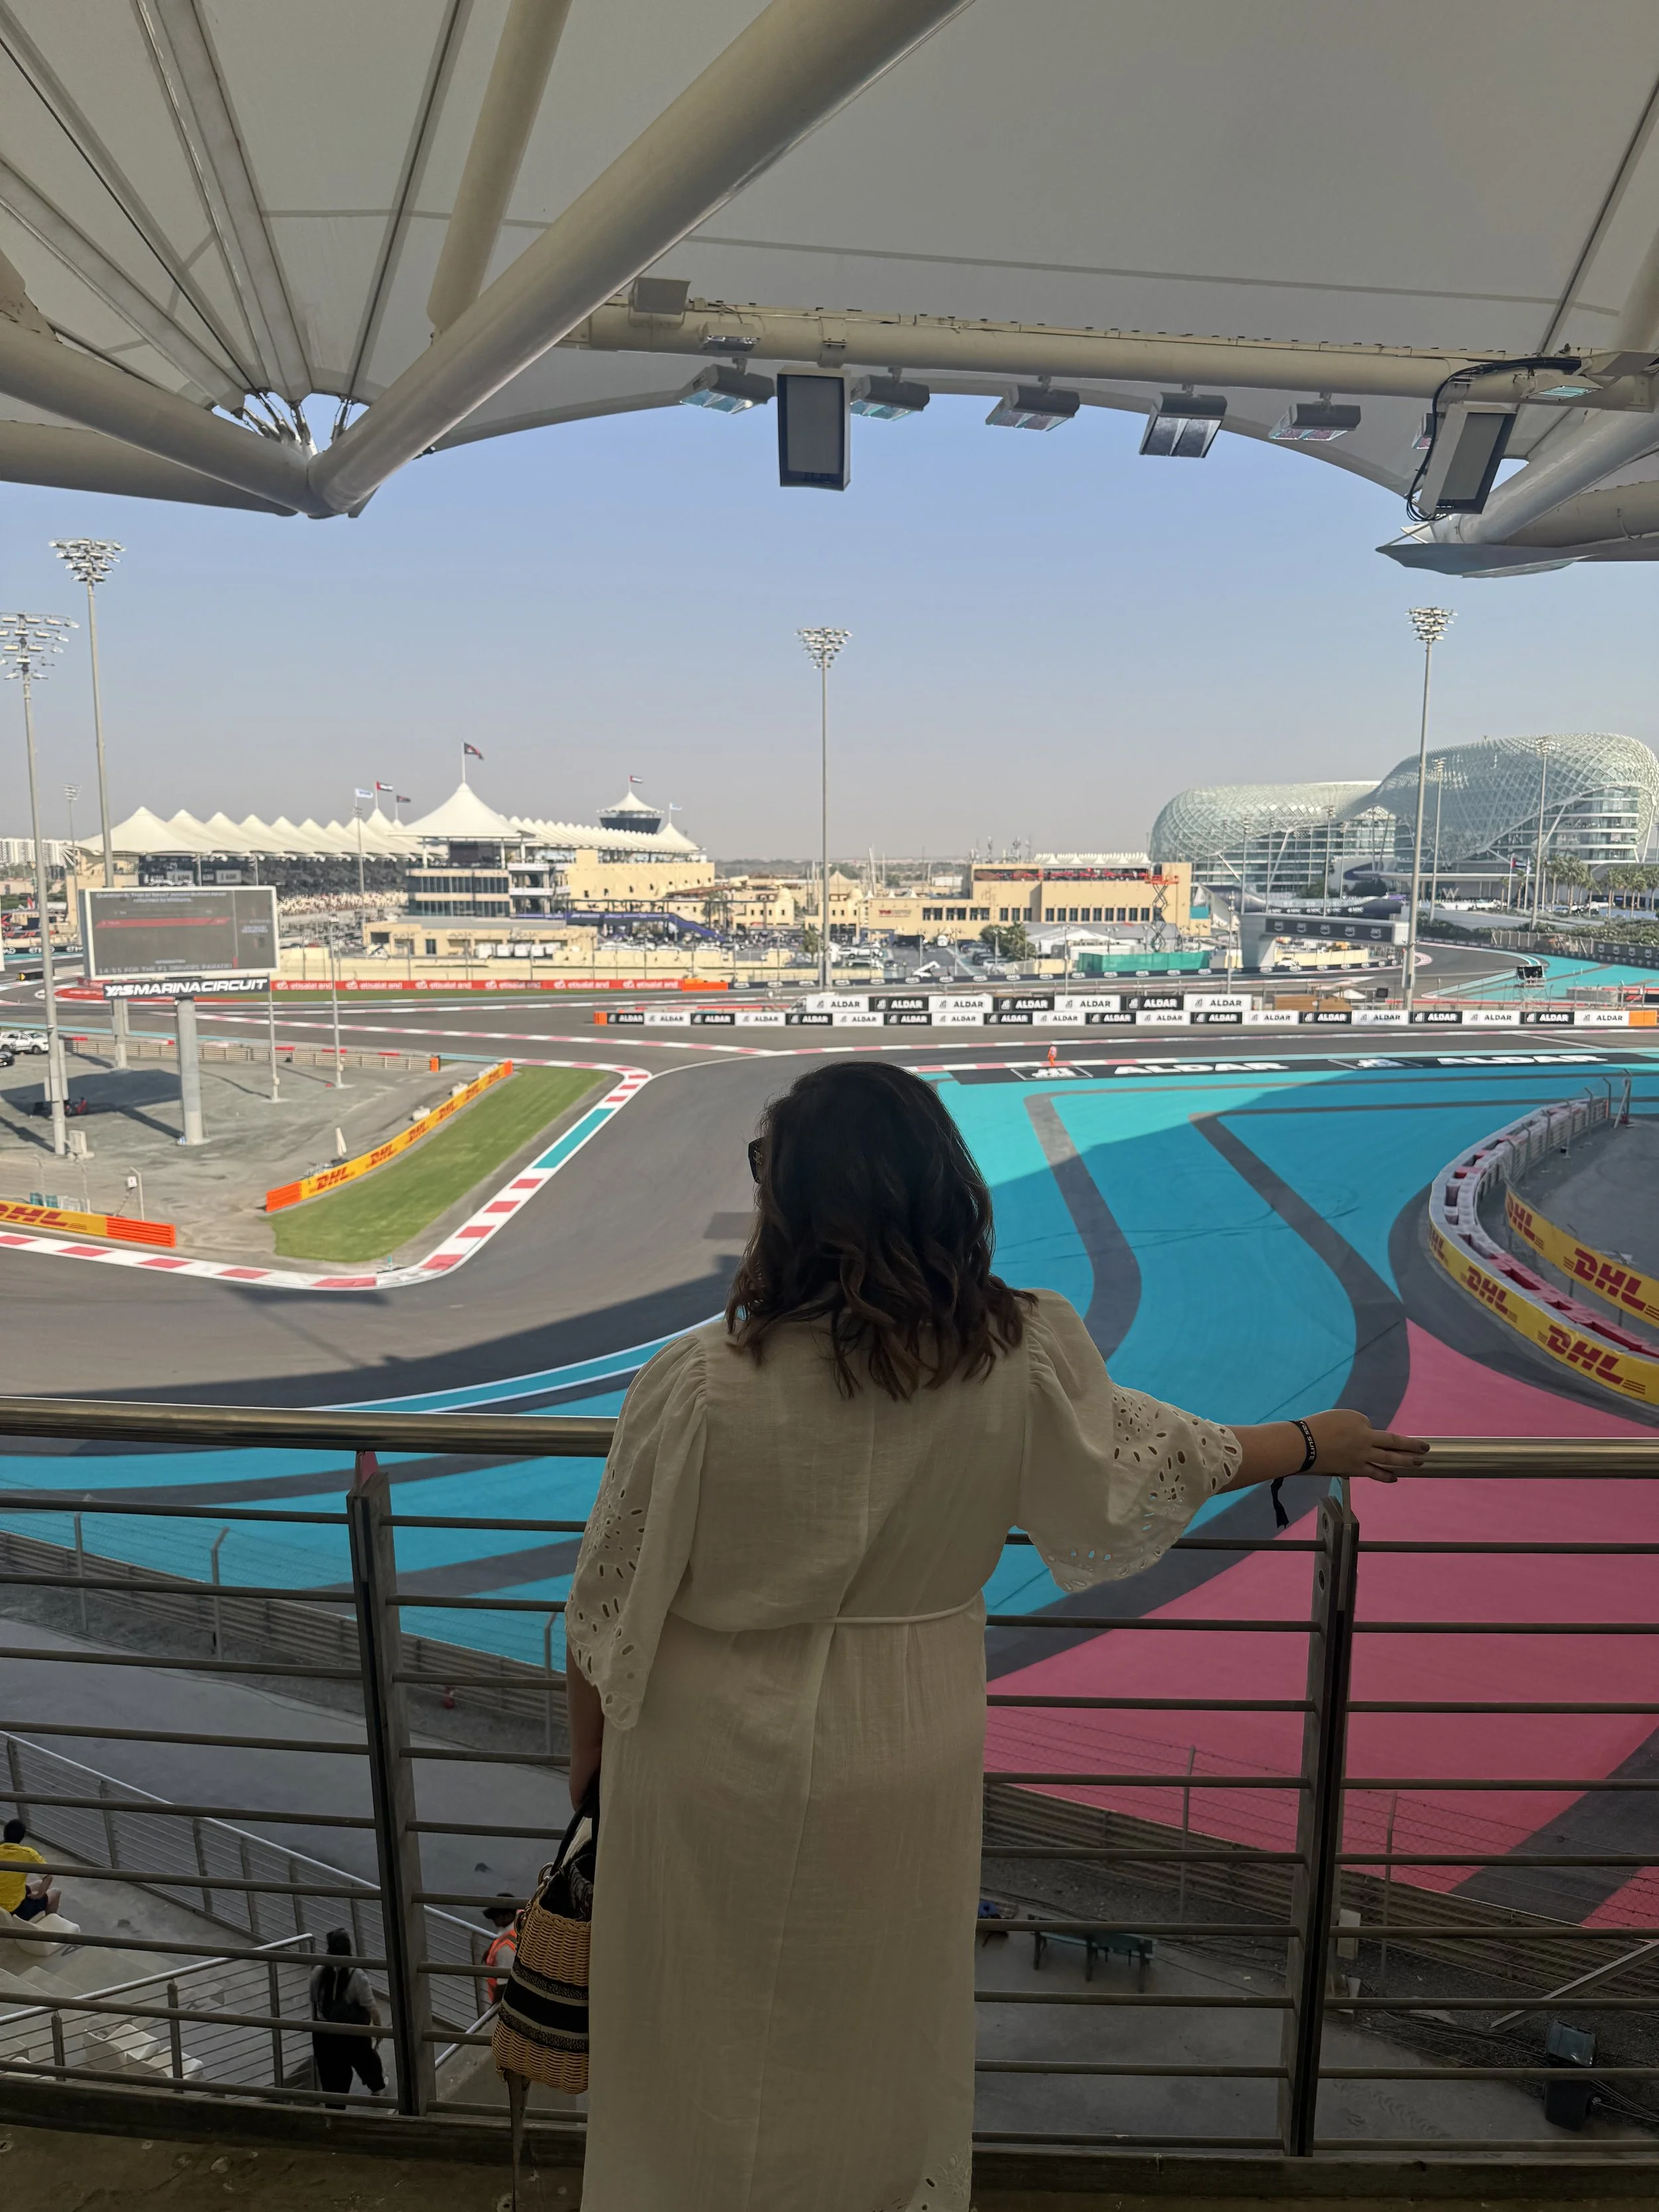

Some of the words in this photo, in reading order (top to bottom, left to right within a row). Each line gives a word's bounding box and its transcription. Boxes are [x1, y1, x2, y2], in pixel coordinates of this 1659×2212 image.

[1442, 887, 1459, 899] W
[891, 1000, 922, 1009] ALDAR
[1015, 999, 1048, 1009] ALDAR
[1143, 999, 1177, 1008] ALDAR
[1208, 1013, 1237, 1022] ALDAR
[1427, 1013, 1458, 1021] ALDAR
[1437, 1055, 1609, 1065] ALDAR
[1114, 1062, 1289, 1074] ALDAR
[369, 1145, 397, 1166] DHL
[317, 1167, 348, 1190] DHL
[1573, 1248, 1646, 1311] DHL
[1467, 1266, 1508, 1315] DHL
[1546, 1325, 1624, 1385] DHL
